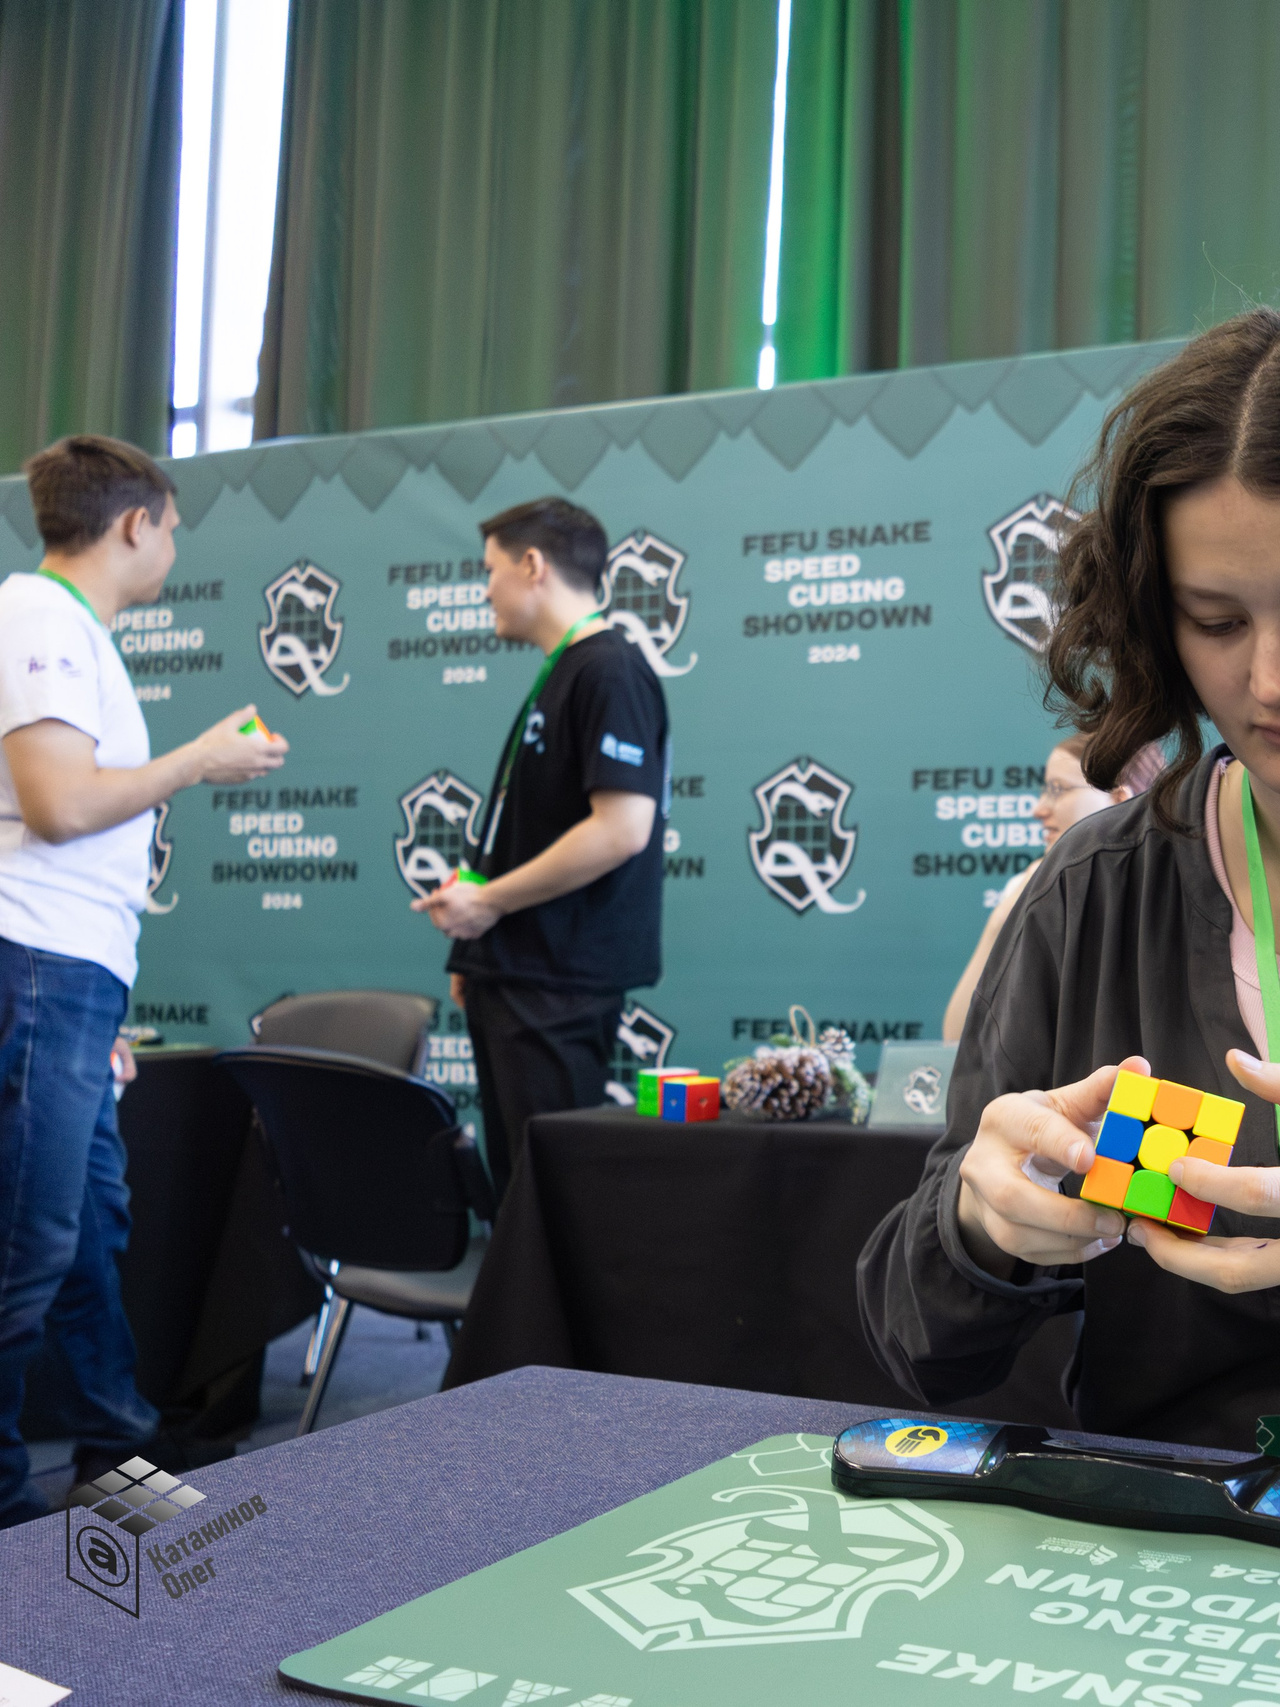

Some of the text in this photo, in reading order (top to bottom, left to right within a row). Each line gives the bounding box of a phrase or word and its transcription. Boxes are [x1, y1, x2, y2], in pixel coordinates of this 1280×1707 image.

[742, 520, 932, 557] FEFU SNAKE
[388, 561, 453, 586] FEFU
[764, 554, 861, 583] SPEED
[157, 580, 224, 603] NAKE
[406, 583, 487, 610] SPEED
[788, 576, 905, 608] CUBING
[426, 606, 497, 633] CUBI
[743, 604, 932, 638] SHOWDOWN
[120, 627, 205, 654] CUBING
[808, 644, 861, 664] 2024
[442, 665, 487, 685] 2024
[912, 767, 994, 791] FEFU
[212, 784, 358, 811] FEFU SNAKE
[936, 795, 1035, 821] SPEED
[229, 813, 304, 835] SPEED
[961, 822, 1046, 848] CUBI
[247, 835, 338, 858] CUBING
[212, 861, 358, 884] SHOWDOWN
[262, 893, 303, 910] 2024
[134, 1003, 208, 1024] SNAKE
[876, 1643, 1203, 1707] SNAKE
